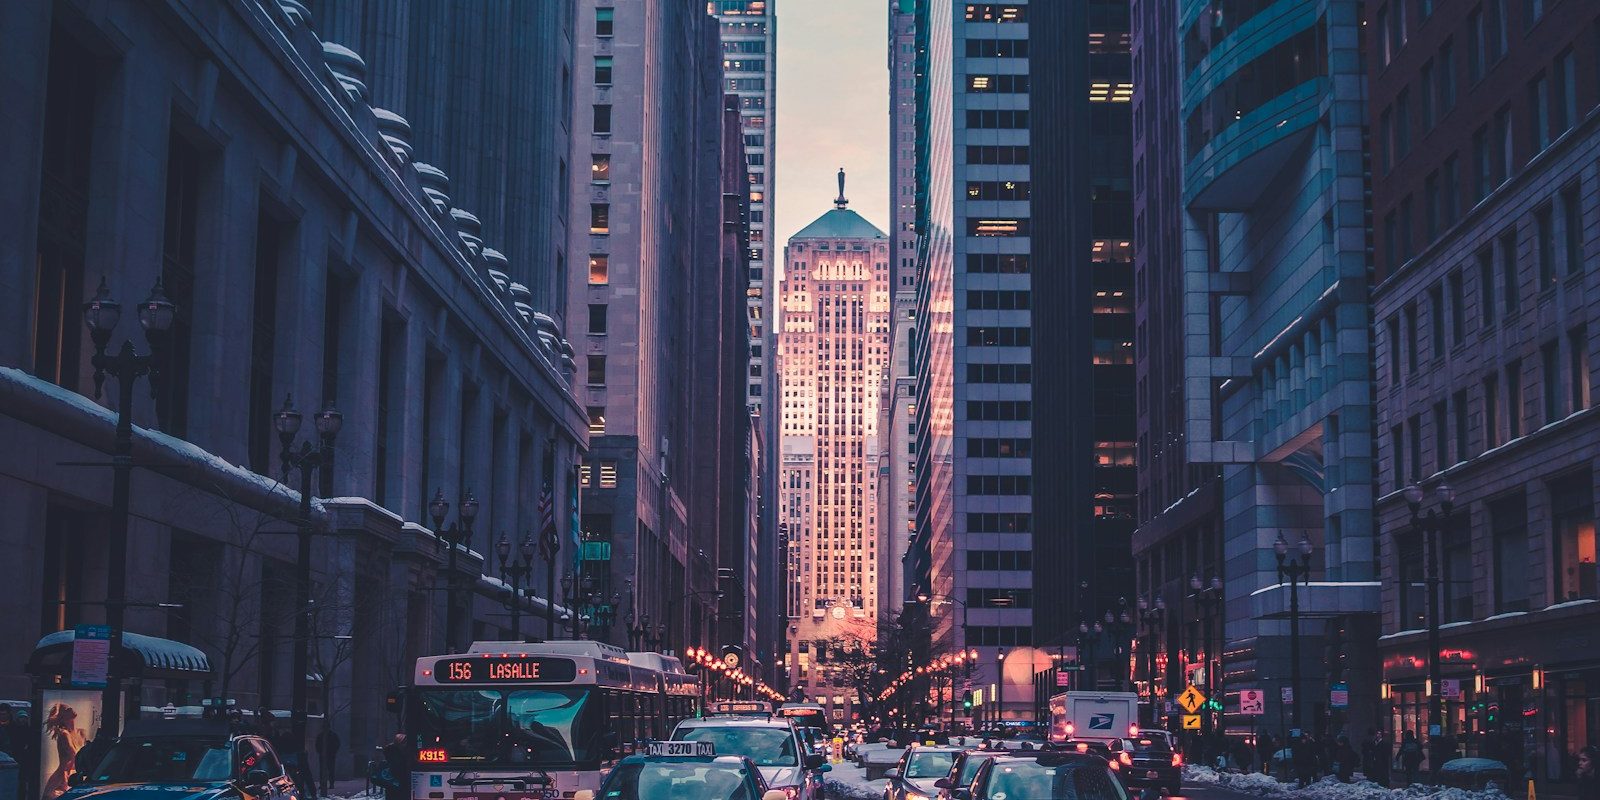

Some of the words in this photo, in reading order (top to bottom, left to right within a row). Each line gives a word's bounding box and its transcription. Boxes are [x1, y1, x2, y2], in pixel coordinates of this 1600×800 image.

[449, 662, 471, 680] 156
[490, 662, 540, 679] LASALLE
[648, 743, 664, 755] TAXI
[668, 743, 692, 755] 3270
[697, 743, 713, 755] TAXI
[418, 750, 445, 761] K915
